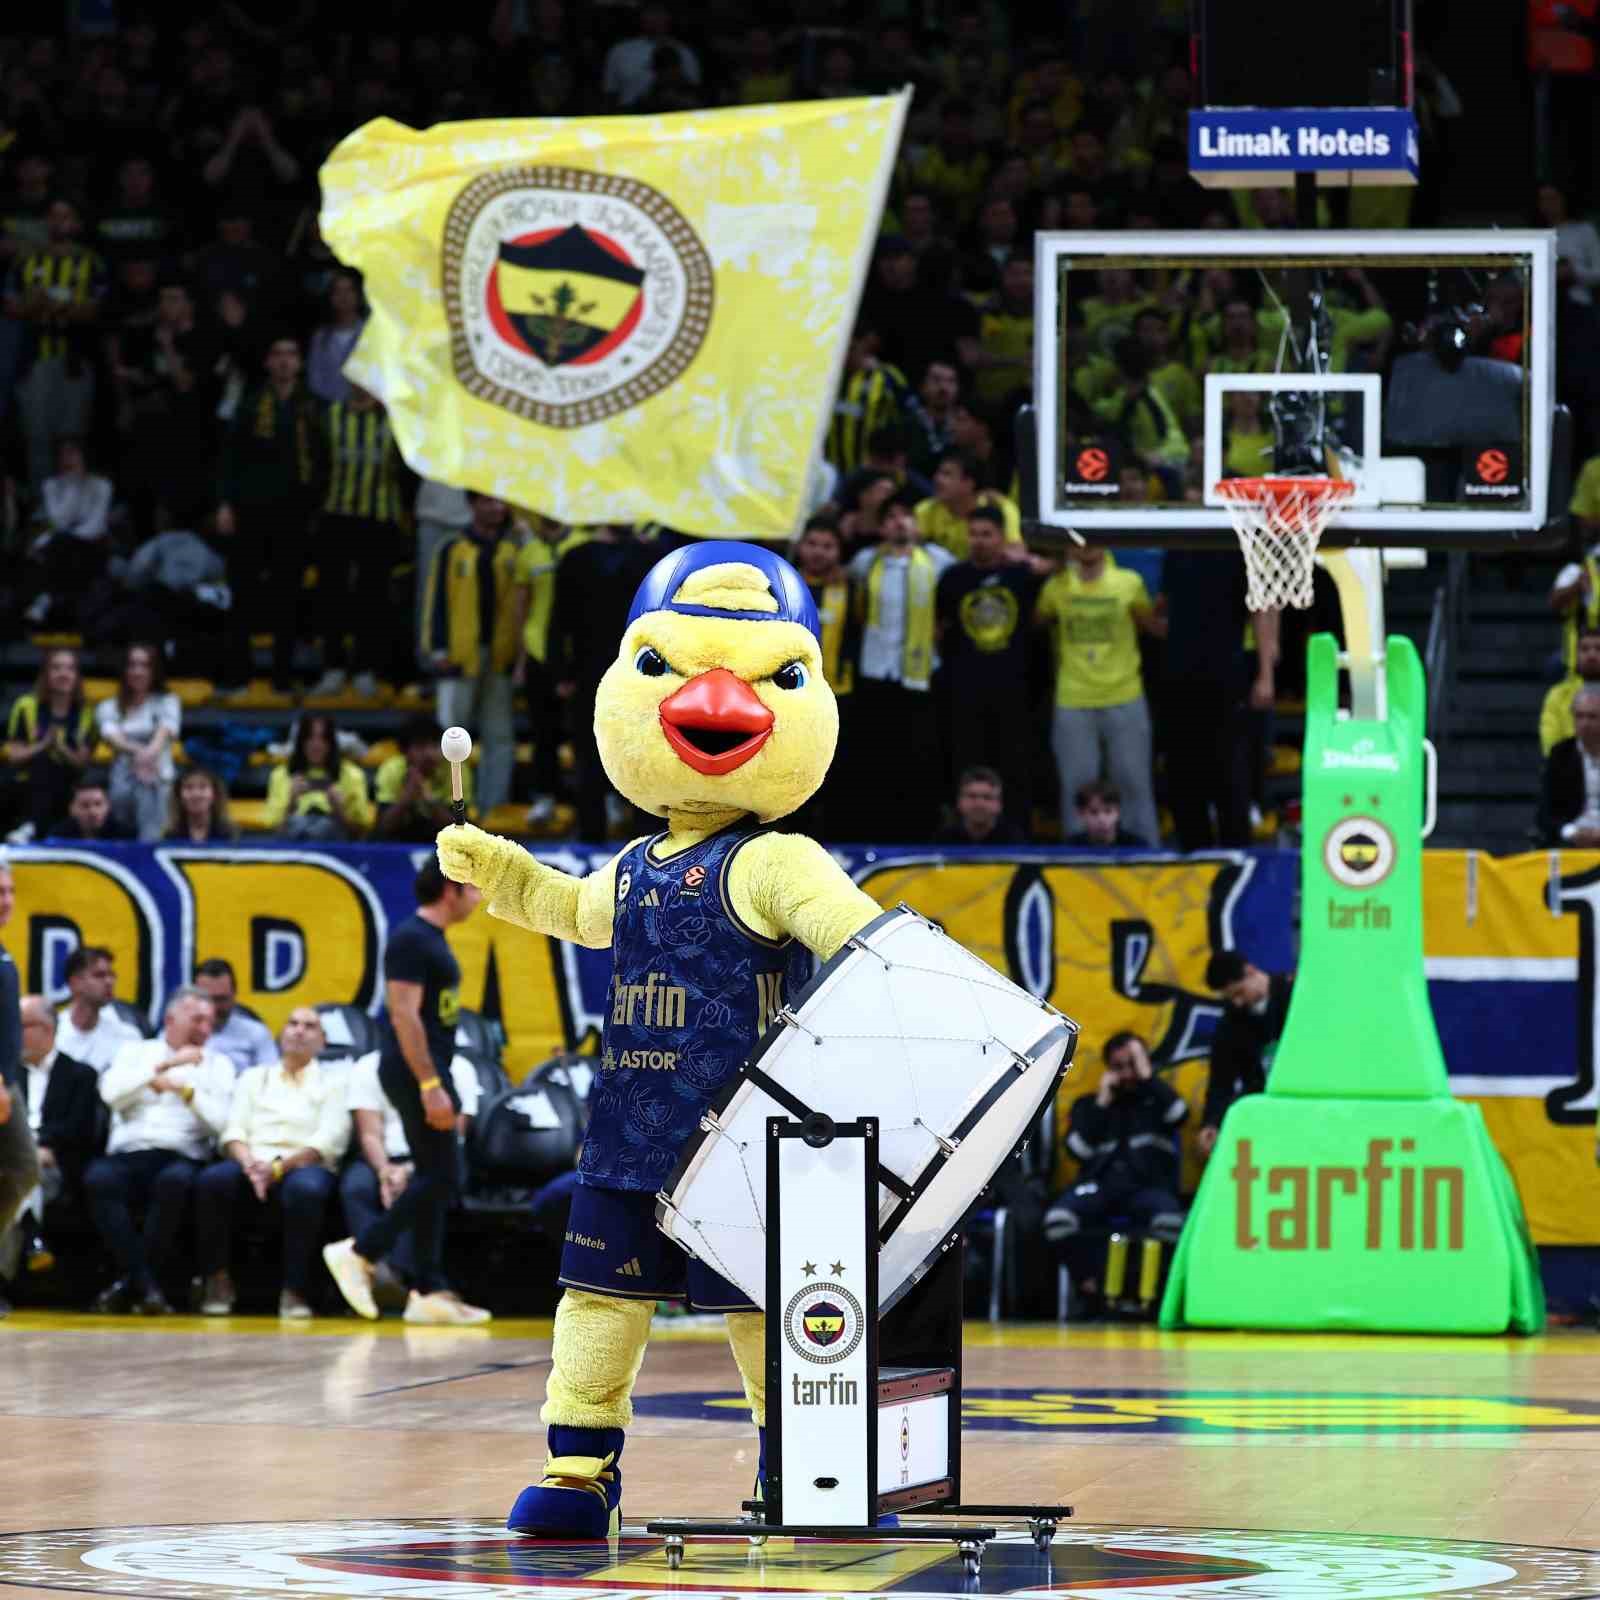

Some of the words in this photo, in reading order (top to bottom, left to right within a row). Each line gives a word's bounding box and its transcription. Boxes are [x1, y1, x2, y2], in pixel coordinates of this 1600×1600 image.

[1200, 126, 1291, 157] Limak
[1297, 126, 1391, 157] Hotels
[1327, 897, 1391, 929] tarfin
[1231, 1138, 1464, 1251] tarfin
[574, 1232, 606, 1250] Hotels
[791, 1372, 858, 1405] tarfin
